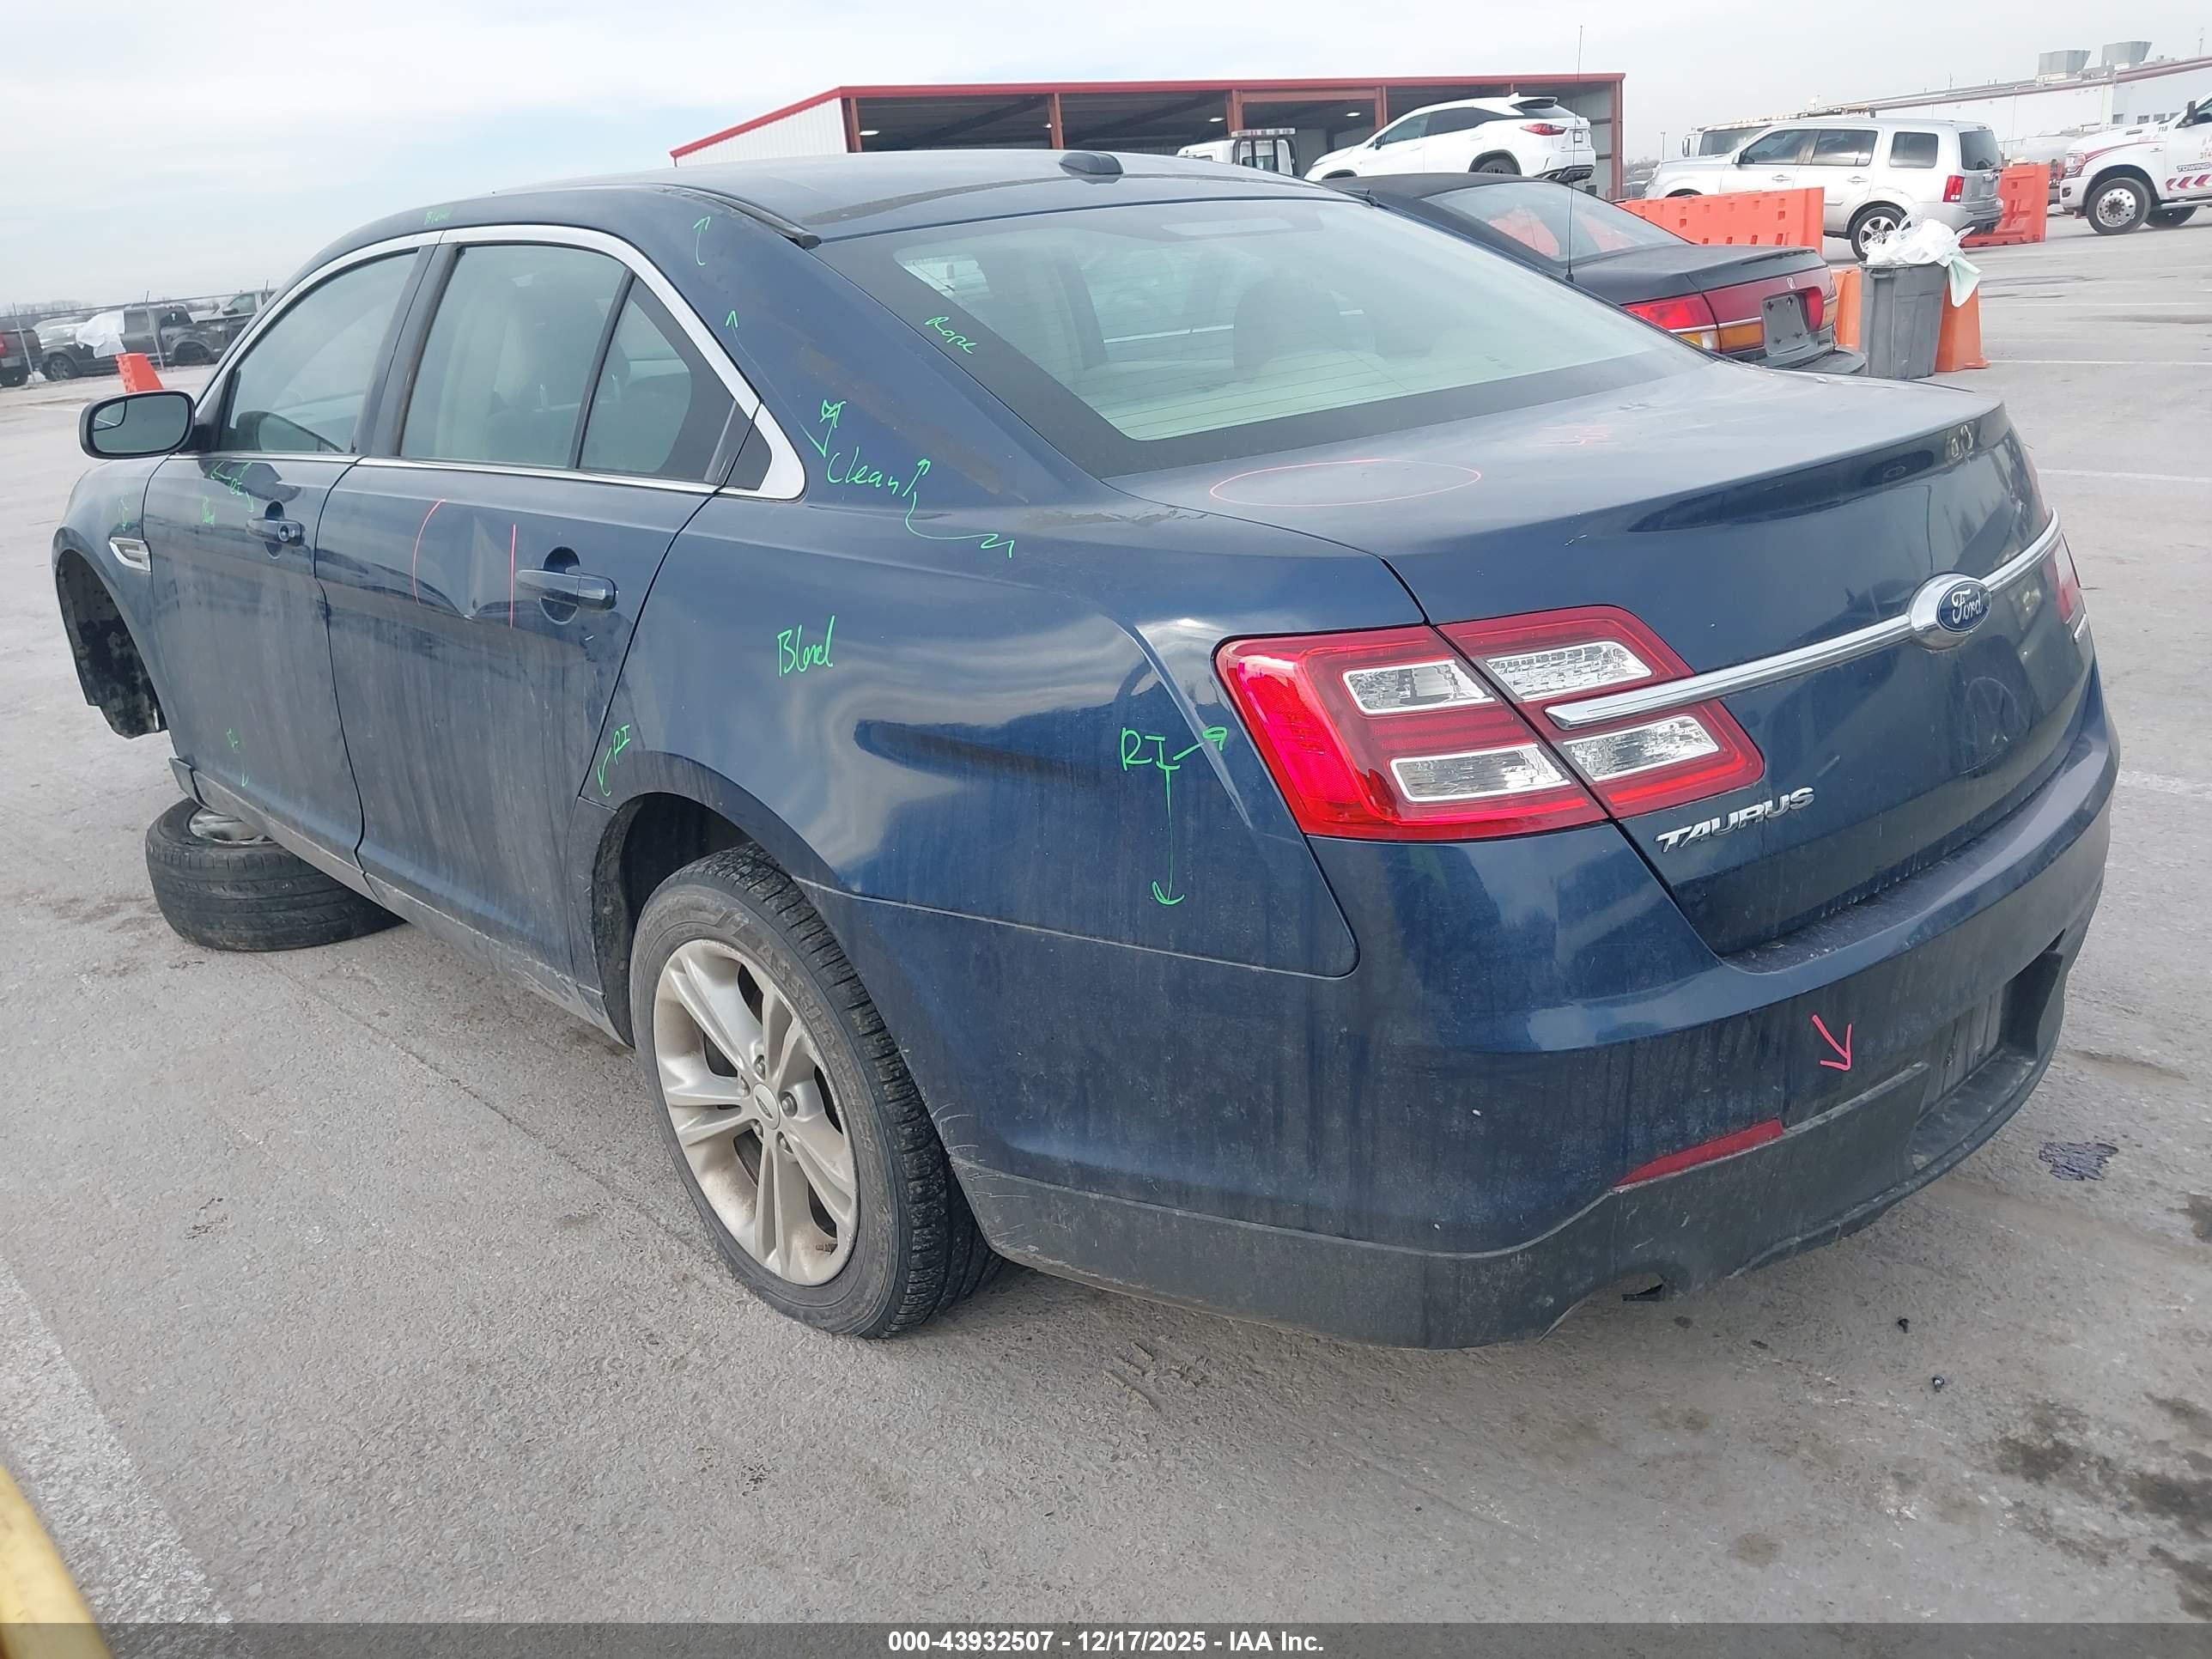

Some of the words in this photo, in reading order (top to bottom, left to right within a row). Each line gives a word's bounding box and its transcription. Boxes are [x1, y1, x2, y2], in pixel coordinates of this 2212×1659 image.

[827, 446, 899, 495] Clean
[1951, 588, 1984, 624] Ford
[1655, 787, 1815, 854] TAURUS
